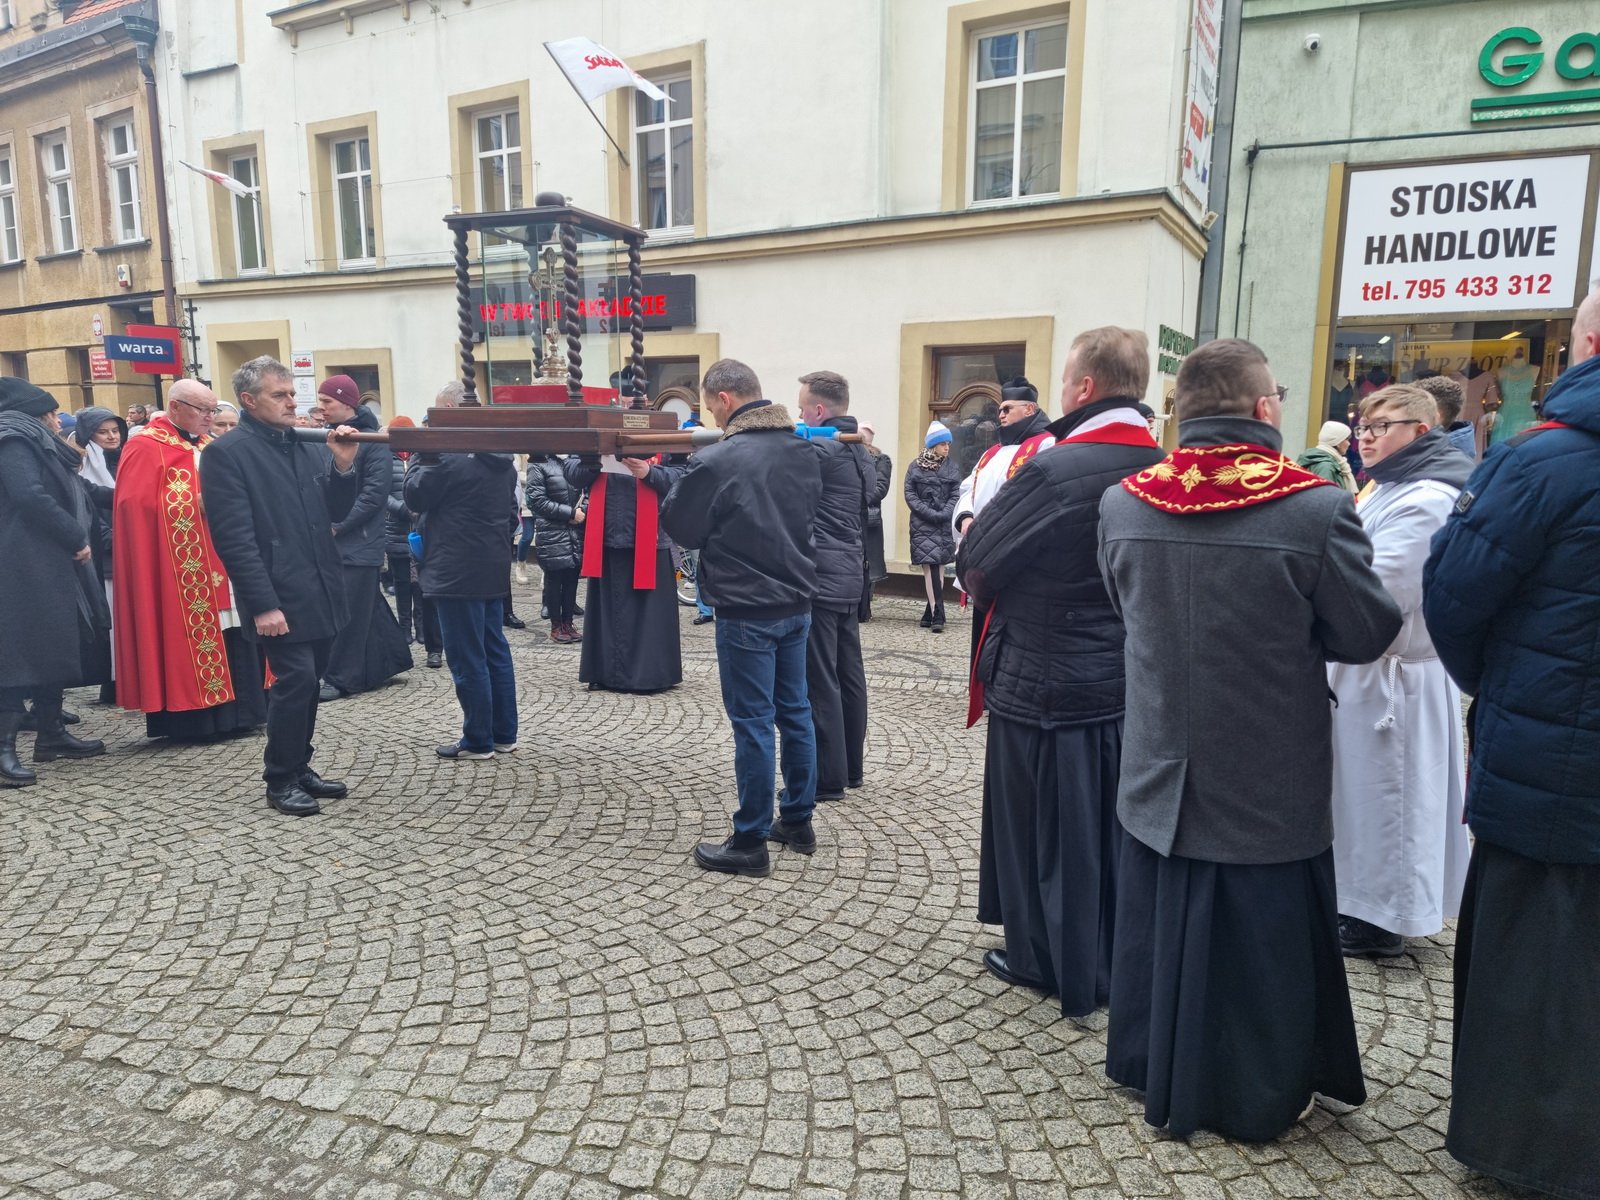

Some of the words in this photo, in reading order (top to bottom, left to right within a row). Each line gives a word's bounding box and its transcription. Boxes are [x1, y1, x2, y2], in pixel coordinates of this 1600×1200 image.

[1390, 178, 1537, 217] STOISKA
[1364, 225, 1557, 265] HANDLOWE
[1362, 280, 1399, 301] tel.
[1405, 278, 1446, 299] 795
[1455, 275, 1499, 297] 433
[1508, 273, 1552, 295] 312
